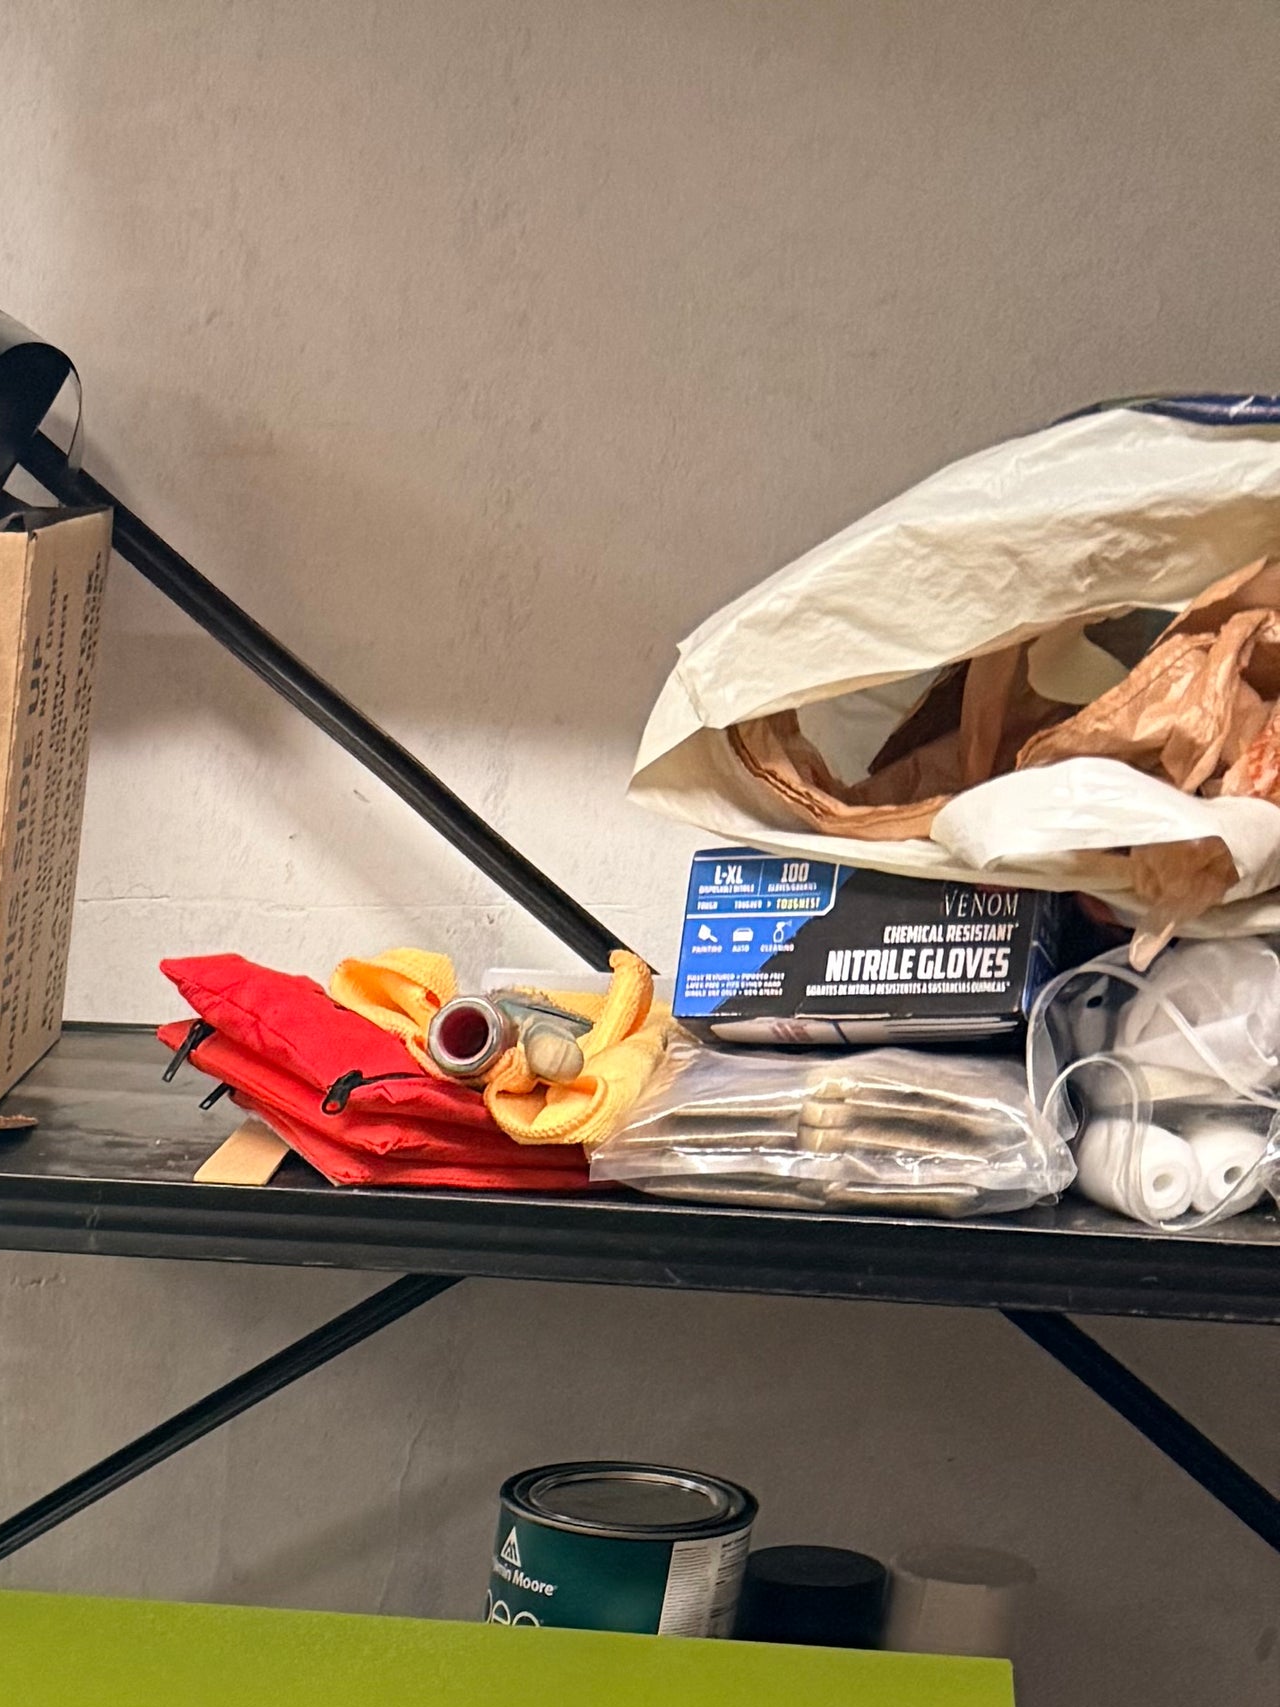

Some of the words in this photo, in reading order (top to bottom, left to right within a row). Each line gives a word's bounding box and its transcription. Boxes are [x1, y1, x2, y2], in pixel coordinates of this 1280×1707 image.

[46, 566, 58, 650] DROP
[0, 888, 19, 1030] THIS
[13, 733, 34, 874] SIDE
[28, 633, 42, 716] UP
[780, 862, 810, 883] 100
[776, 896, 821, 910] TOUGHEST
[944, 890, 1019, 918] VENOM
[883, 925, 944, 944] CHEMICAL
[824, 949, 916, 983] NITRILE
[916, 946, 1011, 981] GLOVES
[512, 1568, 555, 1597] Moore
